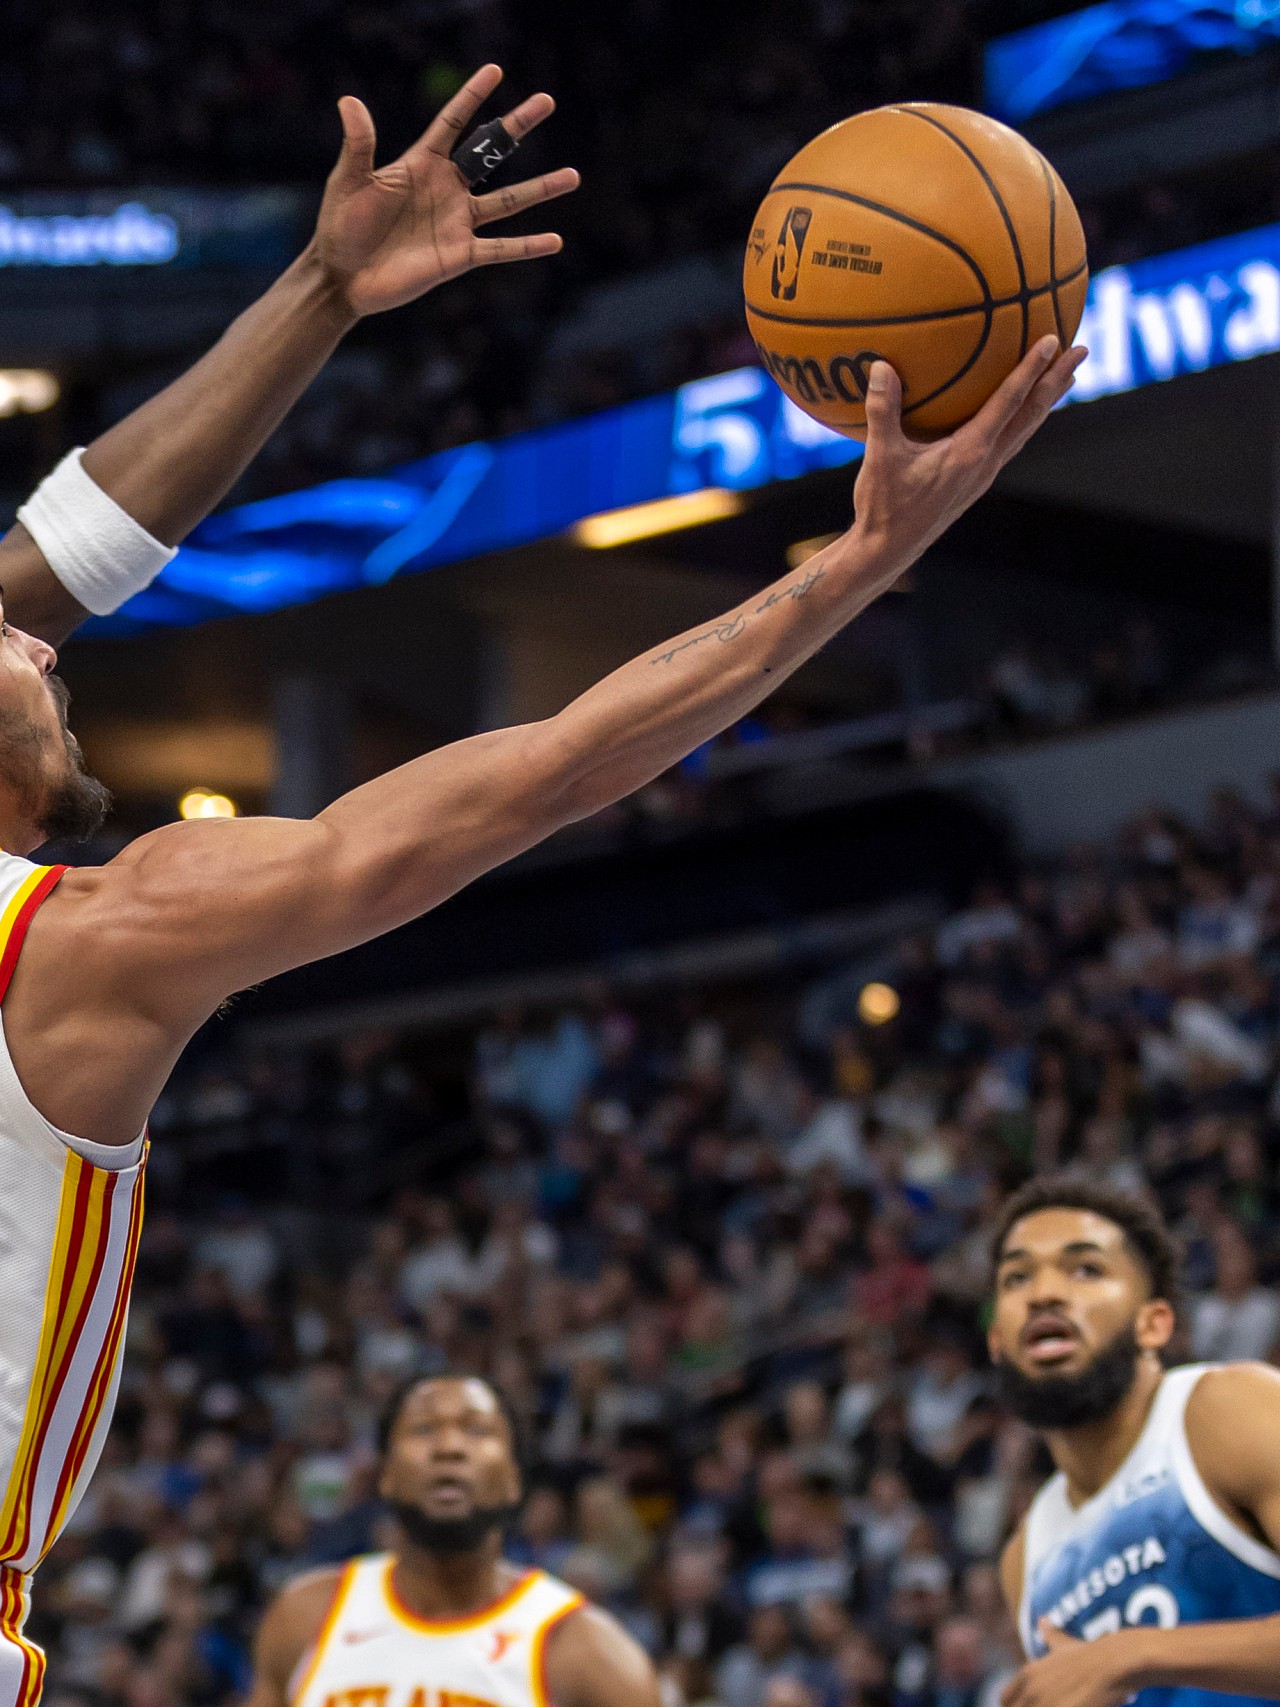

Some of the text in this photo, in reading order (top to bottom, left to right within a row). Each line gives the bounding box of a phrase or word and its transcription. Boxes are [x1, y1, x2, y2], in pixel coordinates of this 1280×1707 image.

[471, 138, 504, 169] 21
[1060, 262, 1280, 406] dwa
[674, 366, 764, 482] 5
